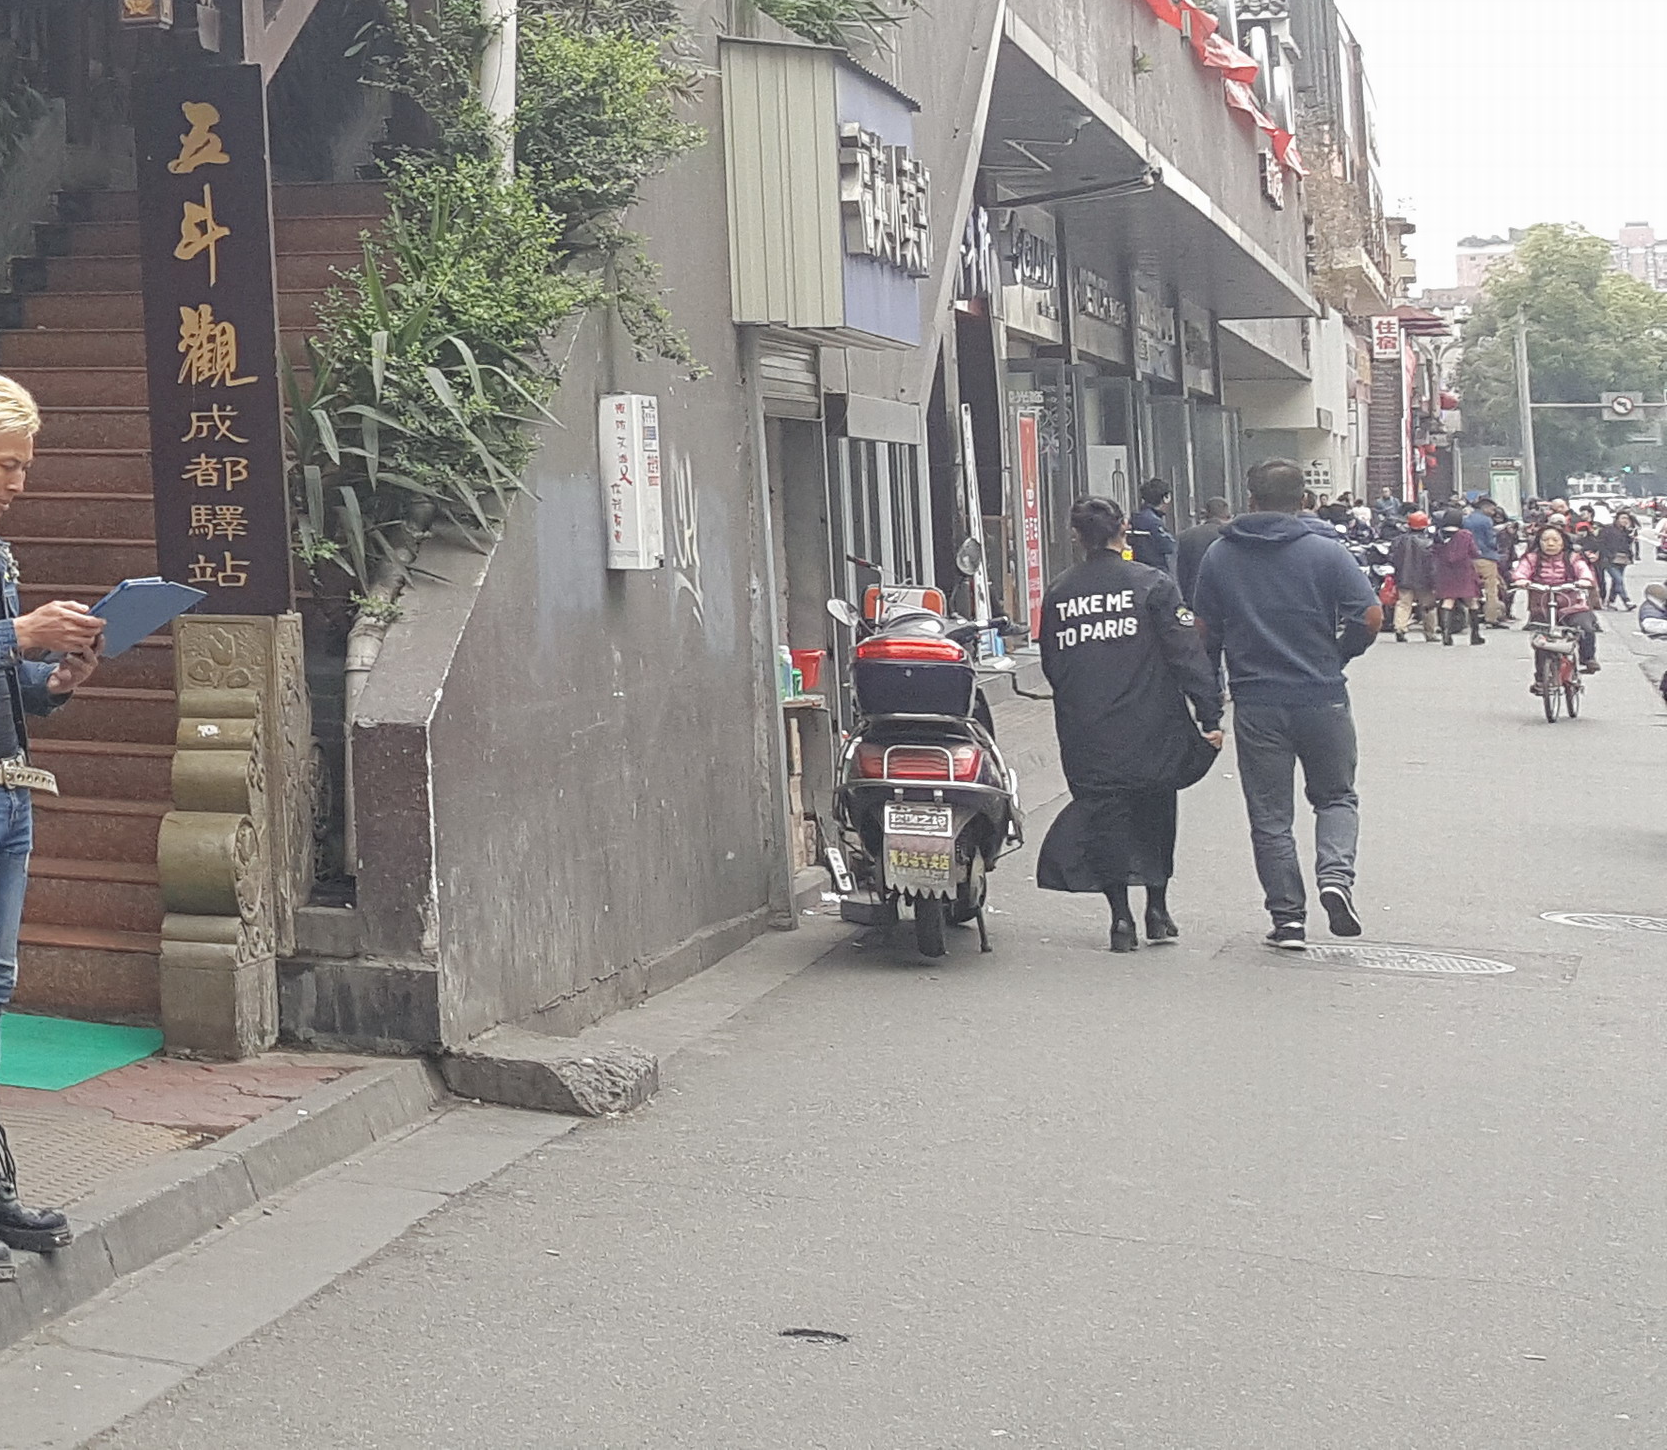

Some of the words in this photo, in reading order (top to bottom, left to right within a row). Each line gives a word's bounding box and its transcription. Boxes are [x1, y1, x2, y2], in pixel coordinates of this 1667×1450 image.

[1375, 320, 1398, 350] 住宿
[1055, 594, 1104, 622] TAKE
[1106, 589, 1134, 612] ME
[1055, 627, 1077, 650] TO
[1080, 617, 1139, 642] PARIS
